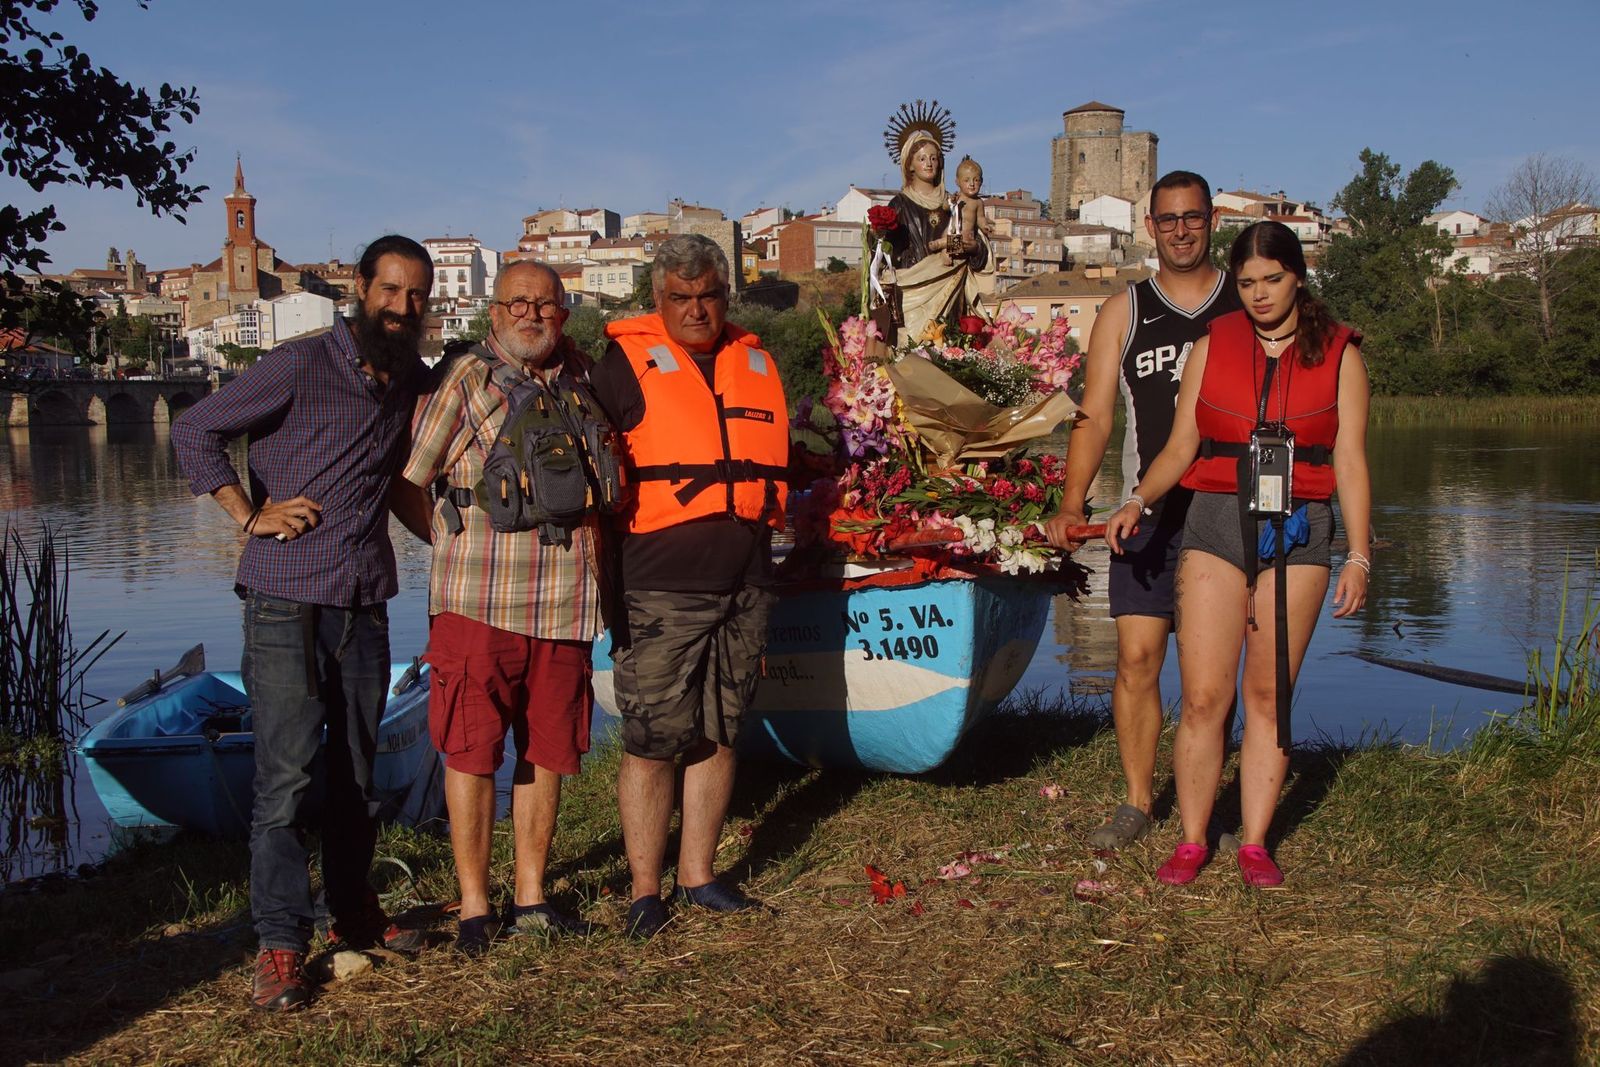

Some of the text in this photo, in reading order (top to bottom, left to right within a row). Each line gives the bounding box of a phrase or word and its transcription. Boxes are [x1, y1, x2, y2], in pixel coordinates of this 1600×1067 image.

[879, 608, 903, 632] 5.
[910, 604, 954, 630] VA.
[858, 634, 939, 661] 3.1490
[761, 660, 814, 686] apá...
